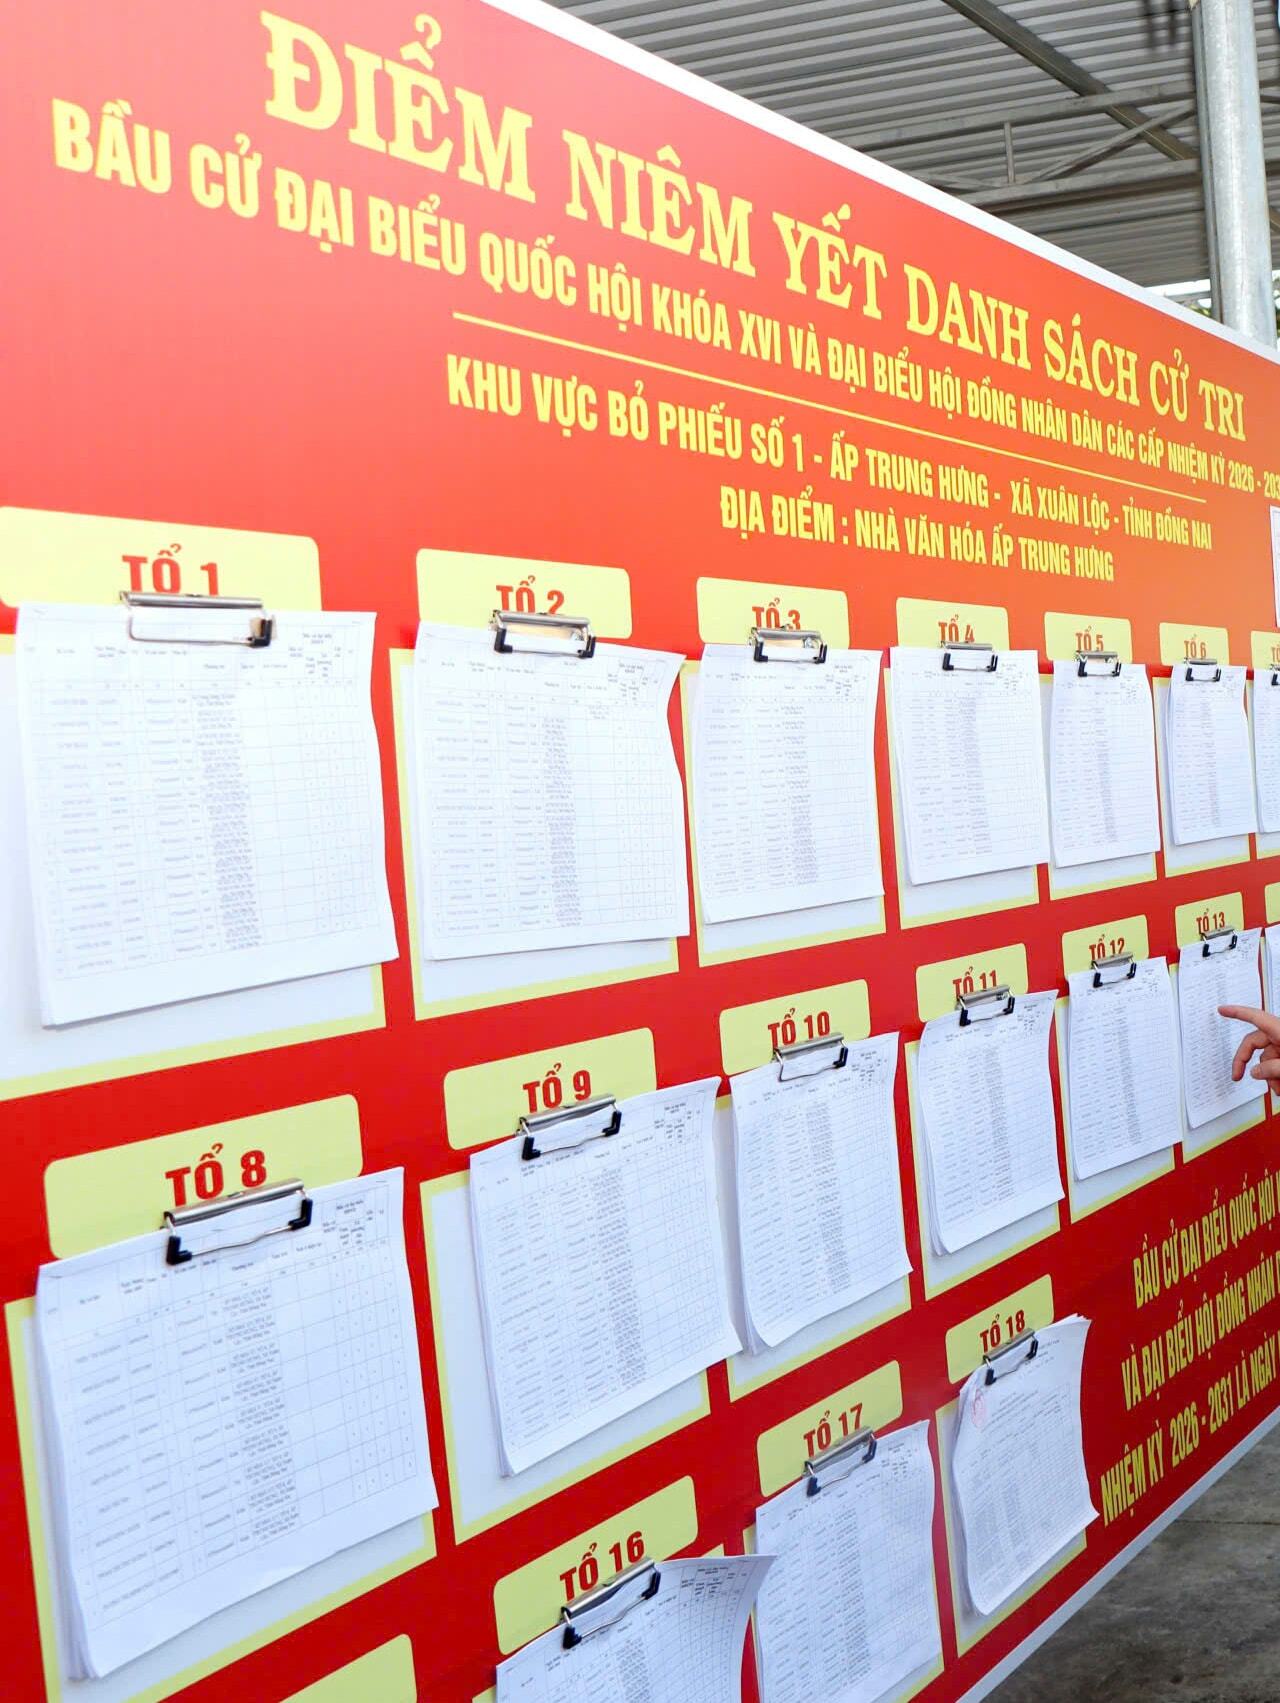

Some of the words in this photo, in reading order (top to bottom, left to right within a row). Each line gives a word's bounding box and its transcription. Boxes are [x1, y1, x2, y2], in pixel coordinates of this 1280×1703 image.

[260, 10, 536, 203] ĐIỂM
[562, 129, 756, 277] NIÊM
[772, 204, 887, 320] YẾT
[904, 264, 1031, 371] DANH
[1043, 313, 1140, 406] SÁCH
[1150, 348, 1189, 422] CỬ
[1199, 379, 1246, 441] TRI
[52, 98, 172, 193] BẦU
[189, 133, 262, 218] CỬ
[274, 167, 354, 253] ĐẠI
[368, 194, 466, 275] BIỂU
[479, 232, 577, 306] QUỐC
[587, 262, 642, 332] HỘI
[652, 283, 732, 350] KHÓA
[738, 310, 781, 364] XVI
[788, 323, 822, 375] VÀ
[827, 337, 867, 393] ĐẠI
[873, 346, 923, 402] BIỂU
[929, 365, 962, 420] HỘI
[967, 376, 1017, 429] ĐỒNG
[1021, 397, 1067, 443] NHÂN
[1071, 410, 1103, 452] DÂN
[1106, 420, 1135, 460] CÁC
[1138, 427, 1164, 468] CẤP
[1168, 441, 1208, 484] NHIỆM
[1210, 451, 1225, 485] KỲ
[1228, 460, 1254, 493] 2026
[447, 354, 521, 416] KHU
[531, 373, 598, 437] VỰC
[608, 380, 649, 441] BỎ
[658, 401, 742, 459] PHIẾU
[751, 416, 785, 467] SỐ
[792, 433, 803, 472] 1
[830, 430, 859, 481] ẤP
[865, 448, 933, 497] TRUNG
[938, 465, 989, 508] HƯNG
[1010, 477, 1034, 517] XÃ
[1037, 485, 1079, 525] XUÂN
[1083, 493, 1110, 535] LỘC
[1122, 497, 1153, 539] TỈNH
[1155, 507, 1189, 545] ĐỒNG
[1191, 520, 1212, 550] NAI
[720, 485, 765, 539] ĐỊA
[772, 485, 835, 543] ĐIỂM
[855, 507, 900, 552] NHÀ
[904, 514, 944, 558] VĂN
[949, 521, 987, 564] HÓA
[992, 523, 1014, 567] ẤP
[1018, 537, 1070, 576] TRUNG
[1074, 545, 1114, 581] HƯNG
[122, 544, 182, 594] TỔ
[201, 562, 219, 596] 1
[496, 575, 536, 613] TỔ
[547, 590, 565, 615] 2
[752, 598, 781, 630] TỔ
[788, 609, 801, 630] 3
[938, 614, 959, 642] TỔ
[965, 625, 975, 643] 4
[1096, 634, 1104, 651] 5
[1200, 642, 1207, 660] 6
[1213, 911, 1226, 930] 13
[1110, 937, 1125, 958] 12
[953, 966, 974, 1001] TỔ
[979, 970, 997, 991] 11
[767, 1007, 797, 1050] TỔ
[803, 1011, 830, 1040] 10
[523, 1063, 563, 1114] TỔ
[573, 1069, 592, 1102] 9
[165, 1143, 224, 1208] TỔ
[240, 1150, 267, 1188] 8
[1132, 1234, 1161, 1309] BẦU
[1162, 1219, 1180, 1289] CỬ
[1180, 1221, 1202, 1282] ĐẠI
[1201, 1188, 1228, 1263] BIỂU
[1229, 1173, 1257, 1248] QUỐC
[1257, 1168, 1276, 1231] HỘI
[980, 1313, 1001, 1354] TỔ
[1006, 1309, 1026, 1339] 18
[1121, 1345, 1142, 1411] VÀ
[1141, 1336, 1166, 1399] ĐẠI
[1165, 1300, 1194, 1378] BIỂU
[1194, 1292, 1216, 1359] HỘI
[1215, 1272, 1247, 1339] ĐỒNG
[1246, 1252, 1276, 1315] NHÂN
[803, 1410, 832, 1459] TỔ
[838, 1402, 863, 1438] 17
[1100, 1444, 1147, 1527] NHIỆM
[1146, 1420, 1164, 1487] KỲ
[1169, 1402, 1200, 1467] 2026
[1207, 1373, 1234, 1433] 2031
[1235, 1354, 1250, 1409] LÀ
[1250, 1332, 1277, 1397] NGÀY
[560, 1542, 600, 1602] TỔ
[608, 1531, 645, 1575] 16
